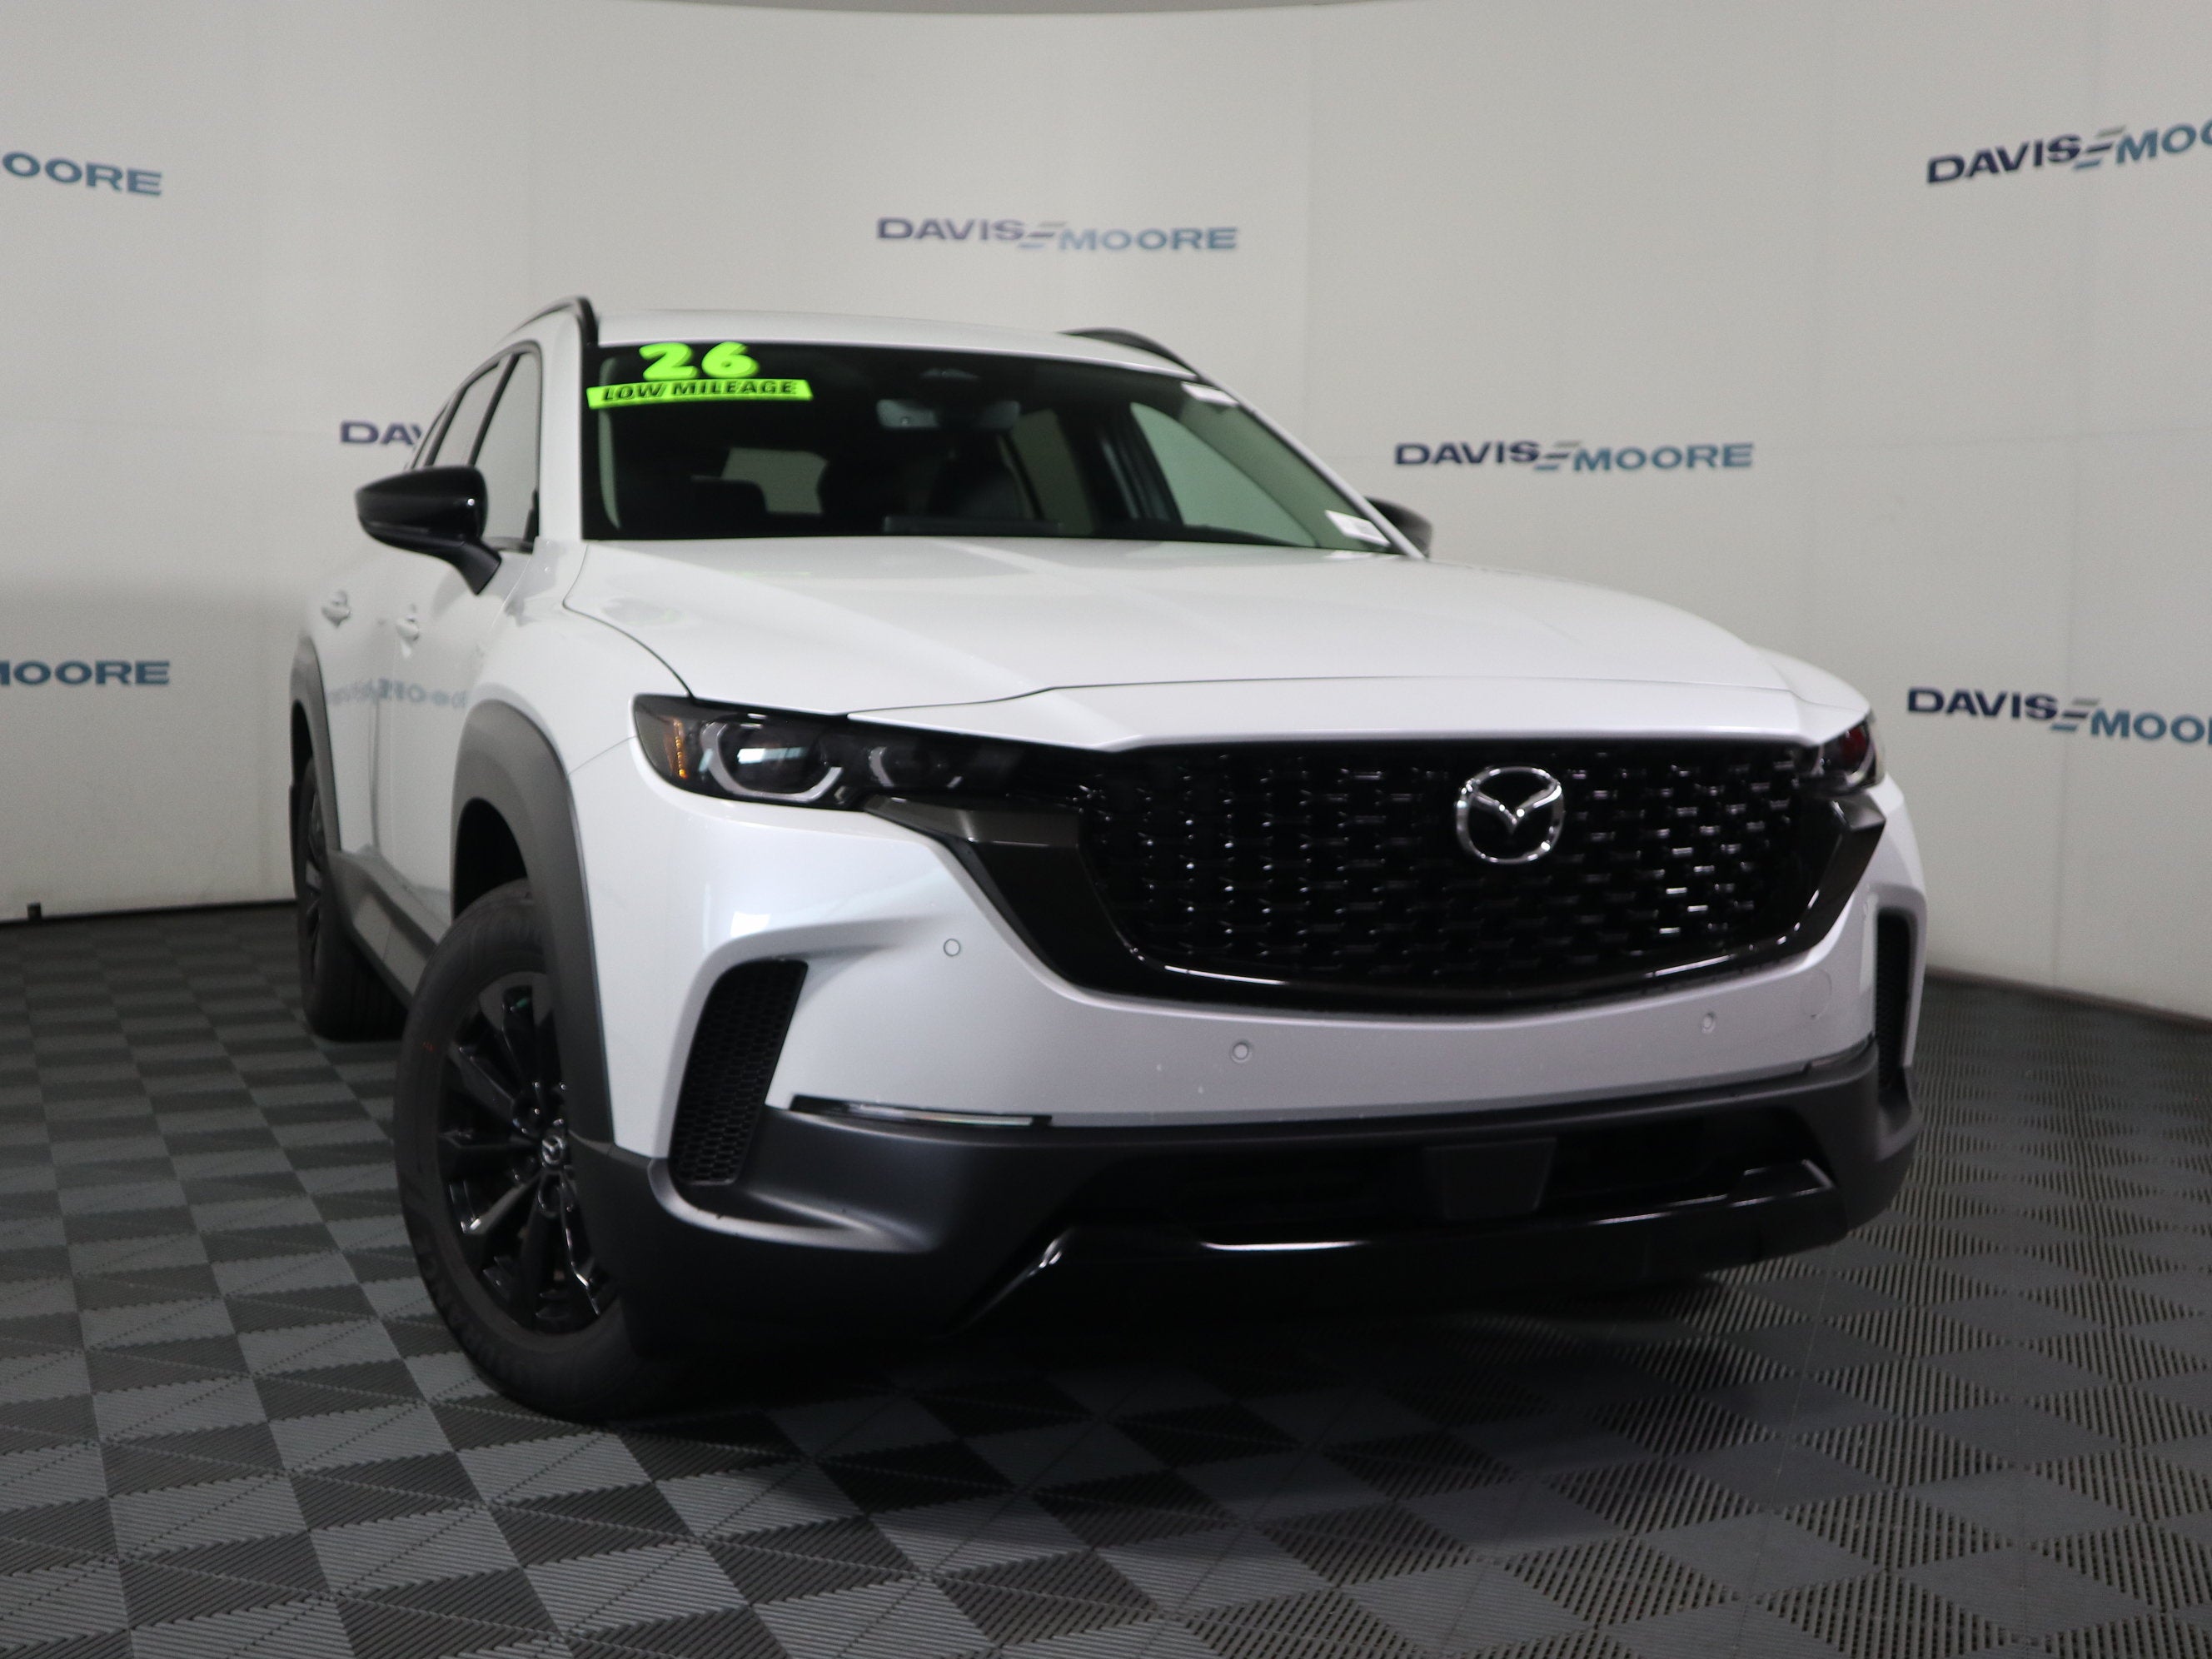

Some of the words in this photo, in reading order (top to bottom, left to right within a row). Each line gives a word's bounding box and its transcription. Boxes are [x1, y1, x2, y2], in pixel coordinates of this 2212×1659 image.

[1926, 135, 2081, 185] DAVIS
[876, 217, 1025, 242] DAVIS
[1059, 227, 1238, 252] MOORE
[639, 341, 760, 381] 26
[601, 382, 666, 401] LOW
[670, 378, 797, 396] MILEAGE
[1394, 441, 1540, 466] DAVIS
[1572, 443, 1754, 473] MOORE
[0, 660, 170, 687] OORE
[1906, 688, 2058, 721] DAVIS
[2090, 709, 2212, 747] MOO
